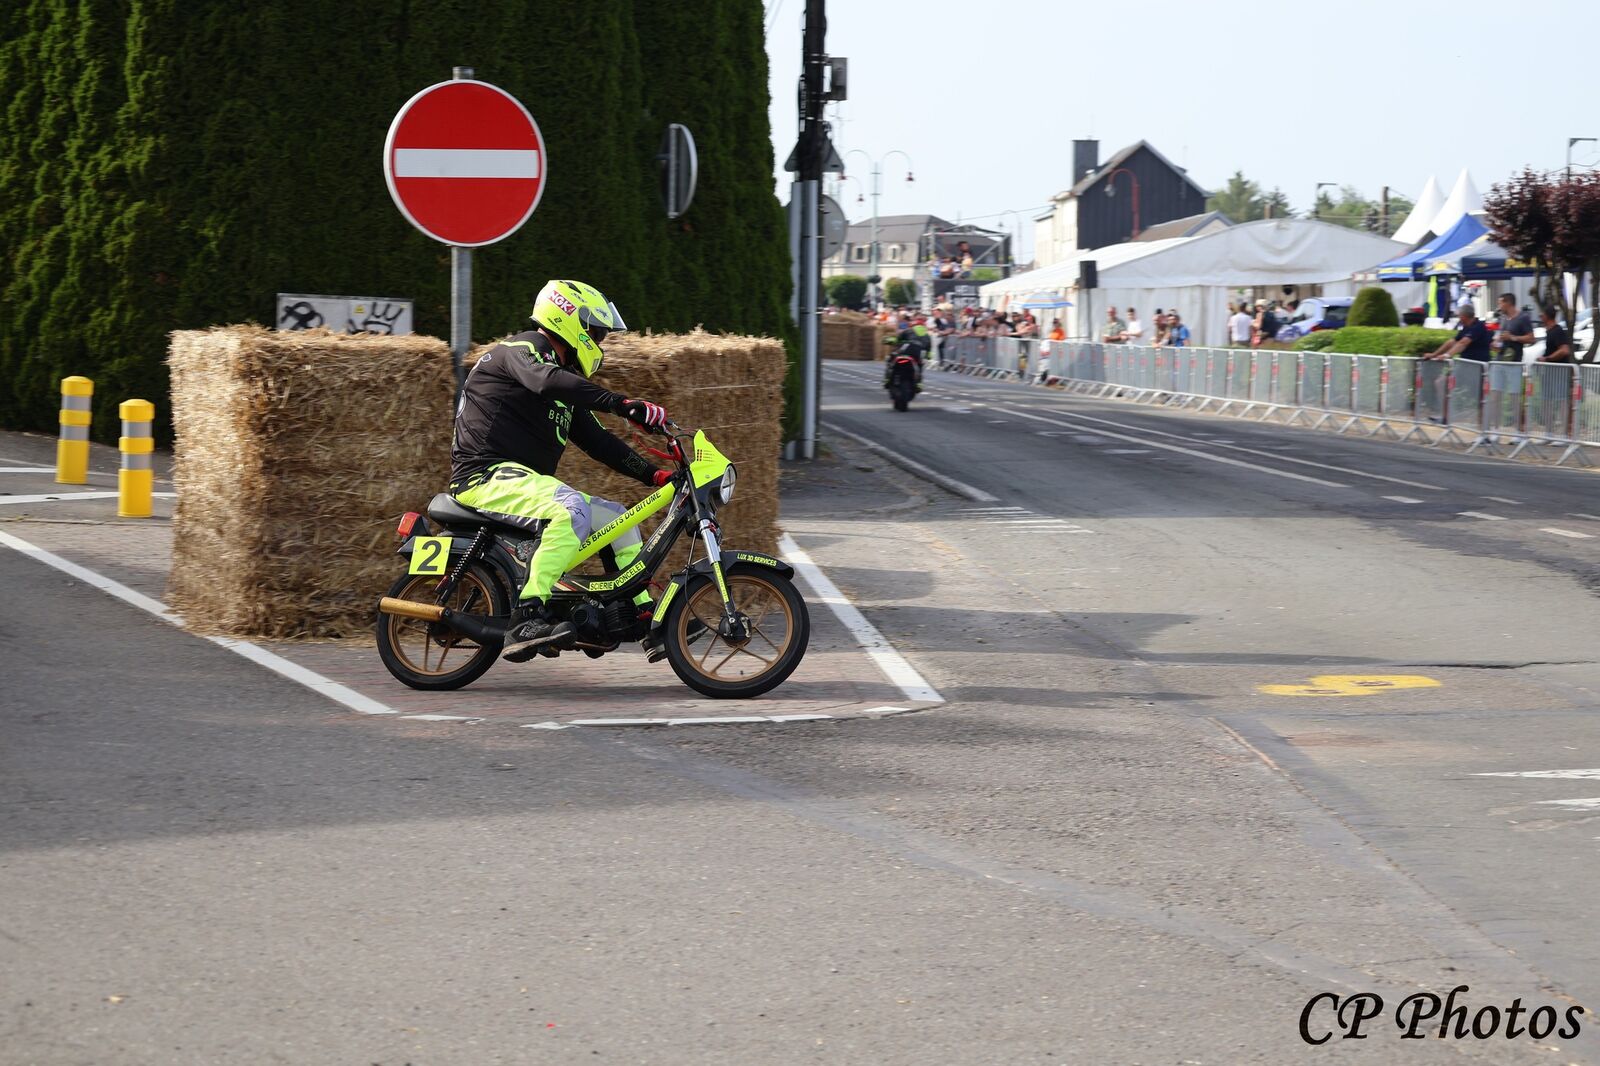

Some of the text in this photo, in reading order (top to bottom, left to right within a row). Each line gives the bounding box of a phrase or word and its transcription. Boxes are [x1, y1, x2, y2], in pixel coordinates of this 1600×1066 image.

[548, 290, 575, 315] NGK
[591, 517, 624, 542] BAUDETS
[624, 510, 635, 520] DU
[635, 492, 662, 513] BITUME
[416, 539, 442, 572] 2
[754, 555, 777, 567] SERVICES
[590, 562, 645, 591] SCIERIE PONCELET
